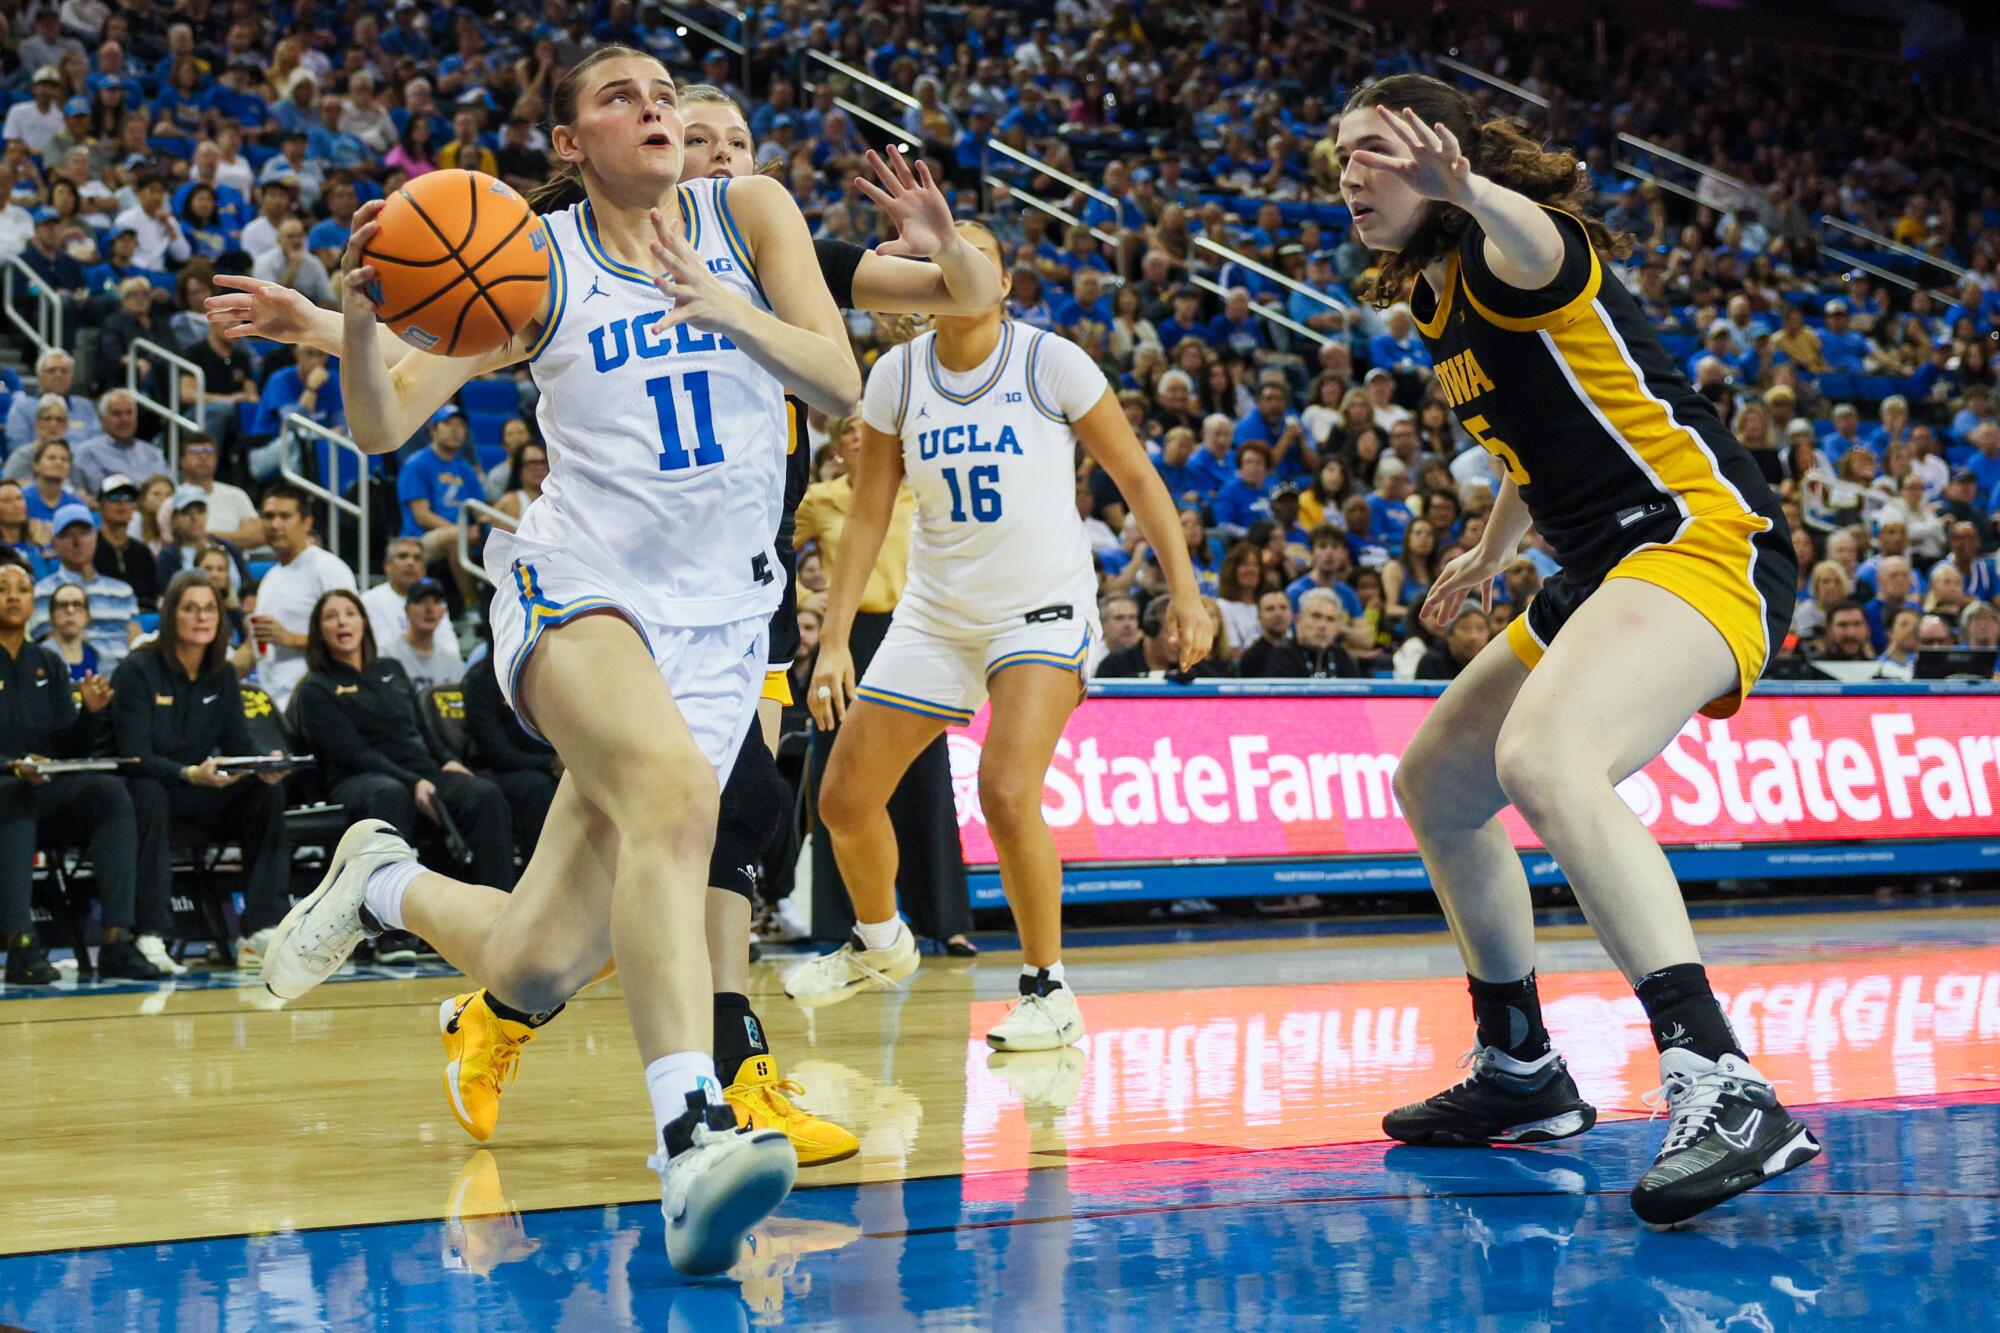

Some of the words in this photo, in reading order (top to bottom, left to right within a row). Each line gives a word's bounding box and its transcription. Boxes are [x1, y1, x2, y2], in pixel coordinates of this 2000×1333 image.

[1433, 348, 1496, 409] OWA
[645, 370, 725, 471] 11
[918, 424, 1024, 461] UCLA
[1461, 414, 1532, 486] 5
[941, 464, 1003, 523] 16
